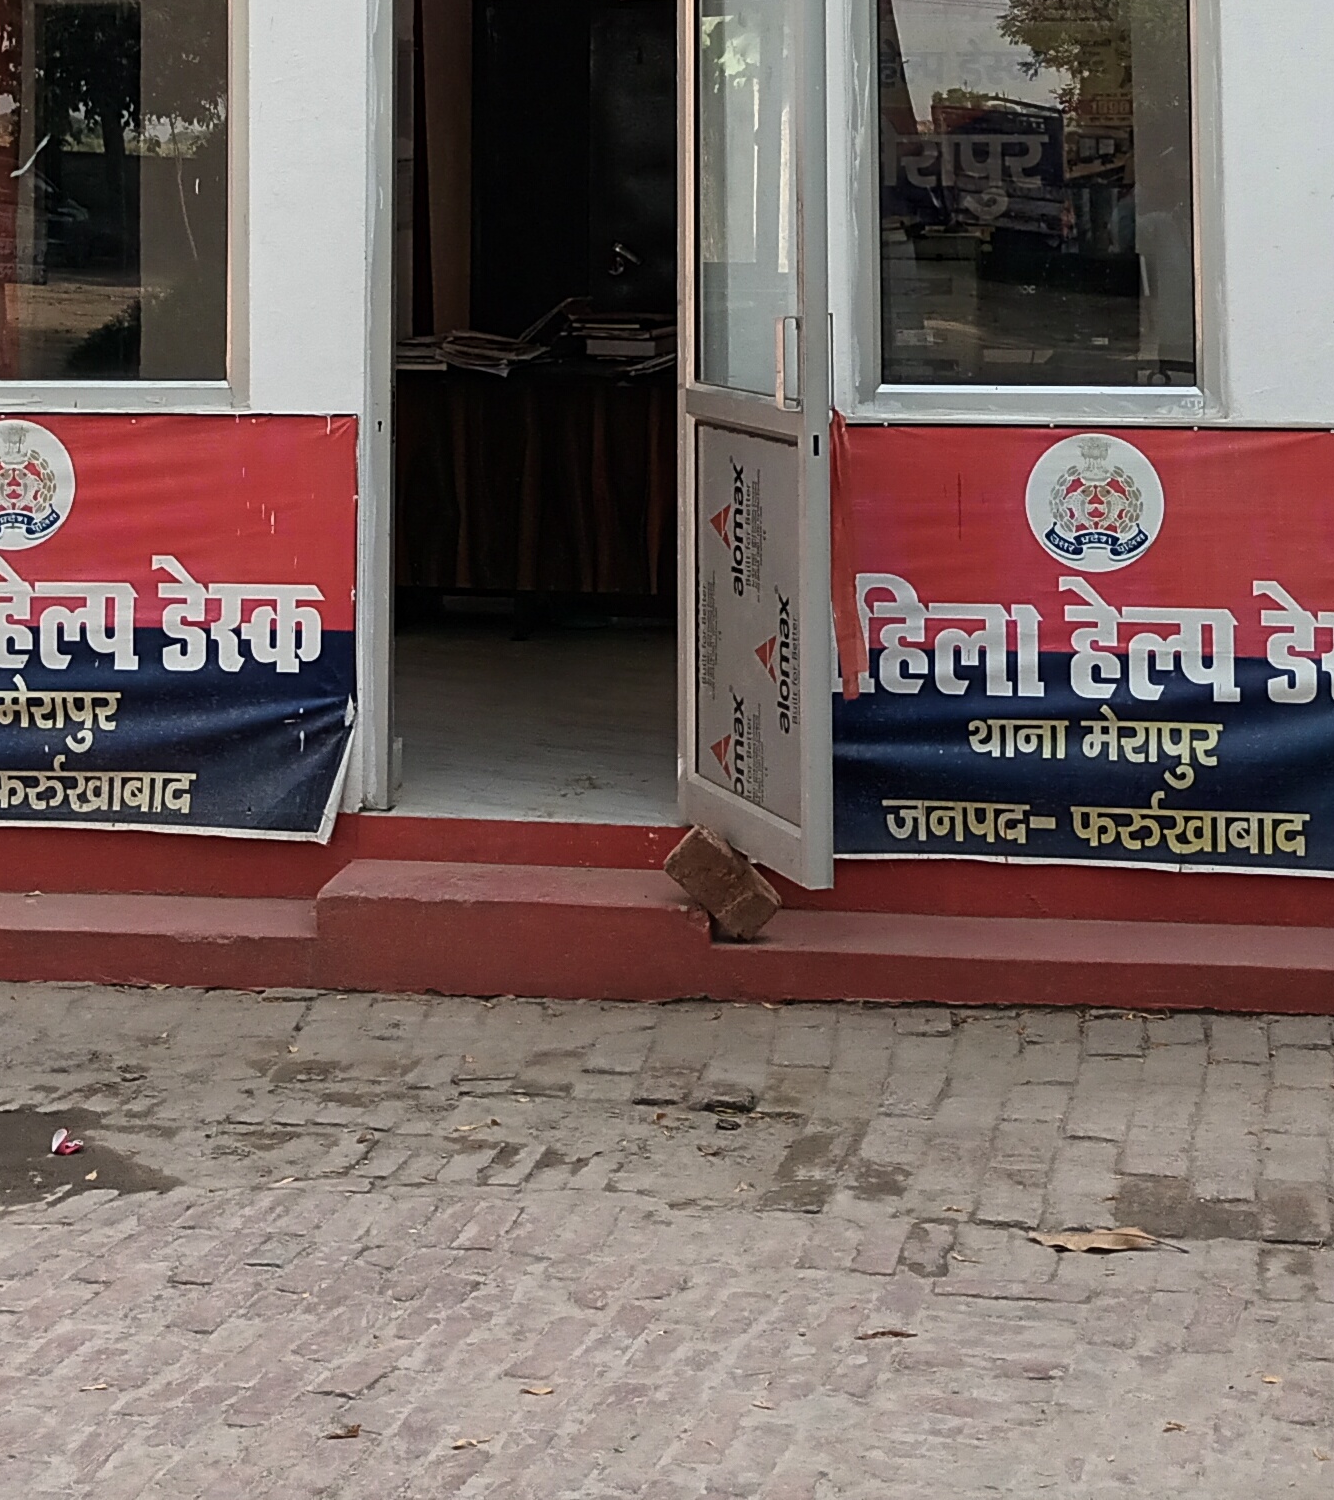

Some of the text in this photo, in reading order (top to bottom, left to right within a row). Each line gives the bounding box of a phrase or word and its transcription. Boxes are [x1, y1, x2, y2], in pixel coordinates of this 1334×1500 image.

[731, 462, 744, 597] alomax
[151, 554, 325, 674] डेस्क
[777, 593, 790, 735] alomax
[1058, 576, 1241, 702] हेल्प
[733, 693, 744, 796] omax
[967, 705, 1223, 789] थाना मेरापुर
